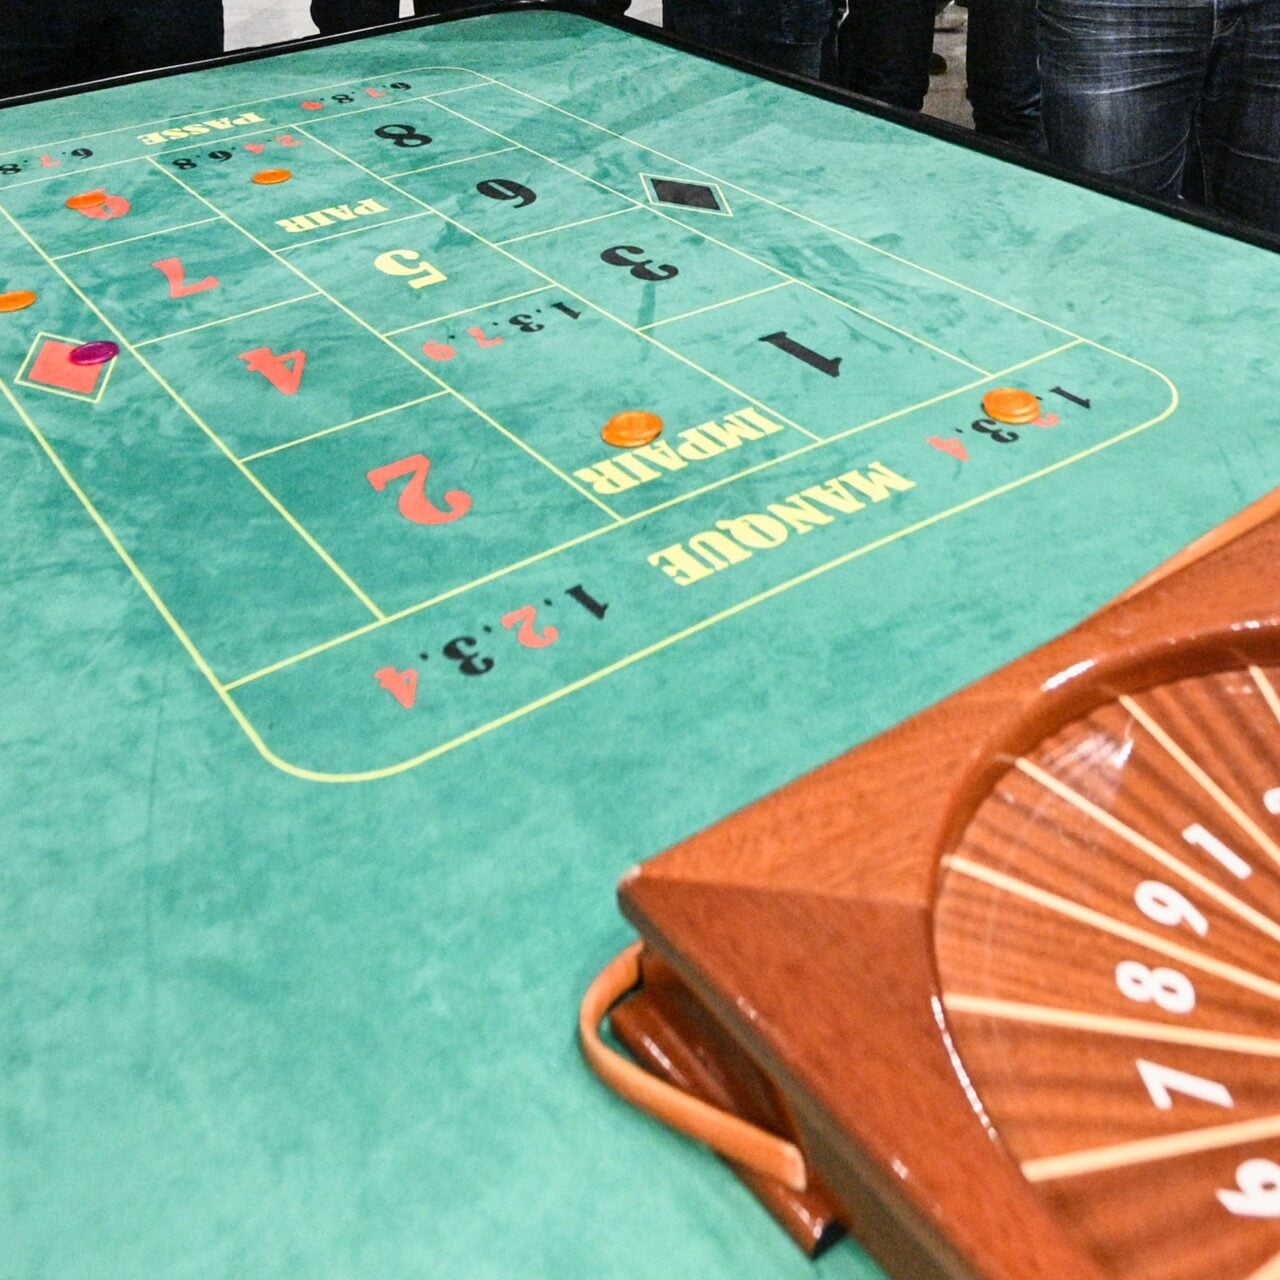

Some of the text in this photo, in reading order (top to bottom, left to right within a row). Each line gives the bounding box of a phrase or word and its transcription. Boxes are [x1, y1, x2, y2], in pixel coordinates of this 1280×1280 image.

[137, 112, 265, 145] PASSE
[374, 124, 432, 148] 8
[275, 197, 390, 233] PAIR
[476, 178, 537, 209] 6
[152, 257, 220, 298] 7
[374, 249, 447, 289] 5
[600, 245, 679, 281] 3
[239, 347, 306, 395] 4
[758, 331, 842, 377] 1
[573, 407, 784, 496] IMPAIR
[367, 453, 472, 525] 2
[647, 461, 916, 586] MANQUE
[1182, 823, 1252, 880] 1
[1115, 961, 1196, 1013] 8
[1135, 1058, 1234, 1110] 7
